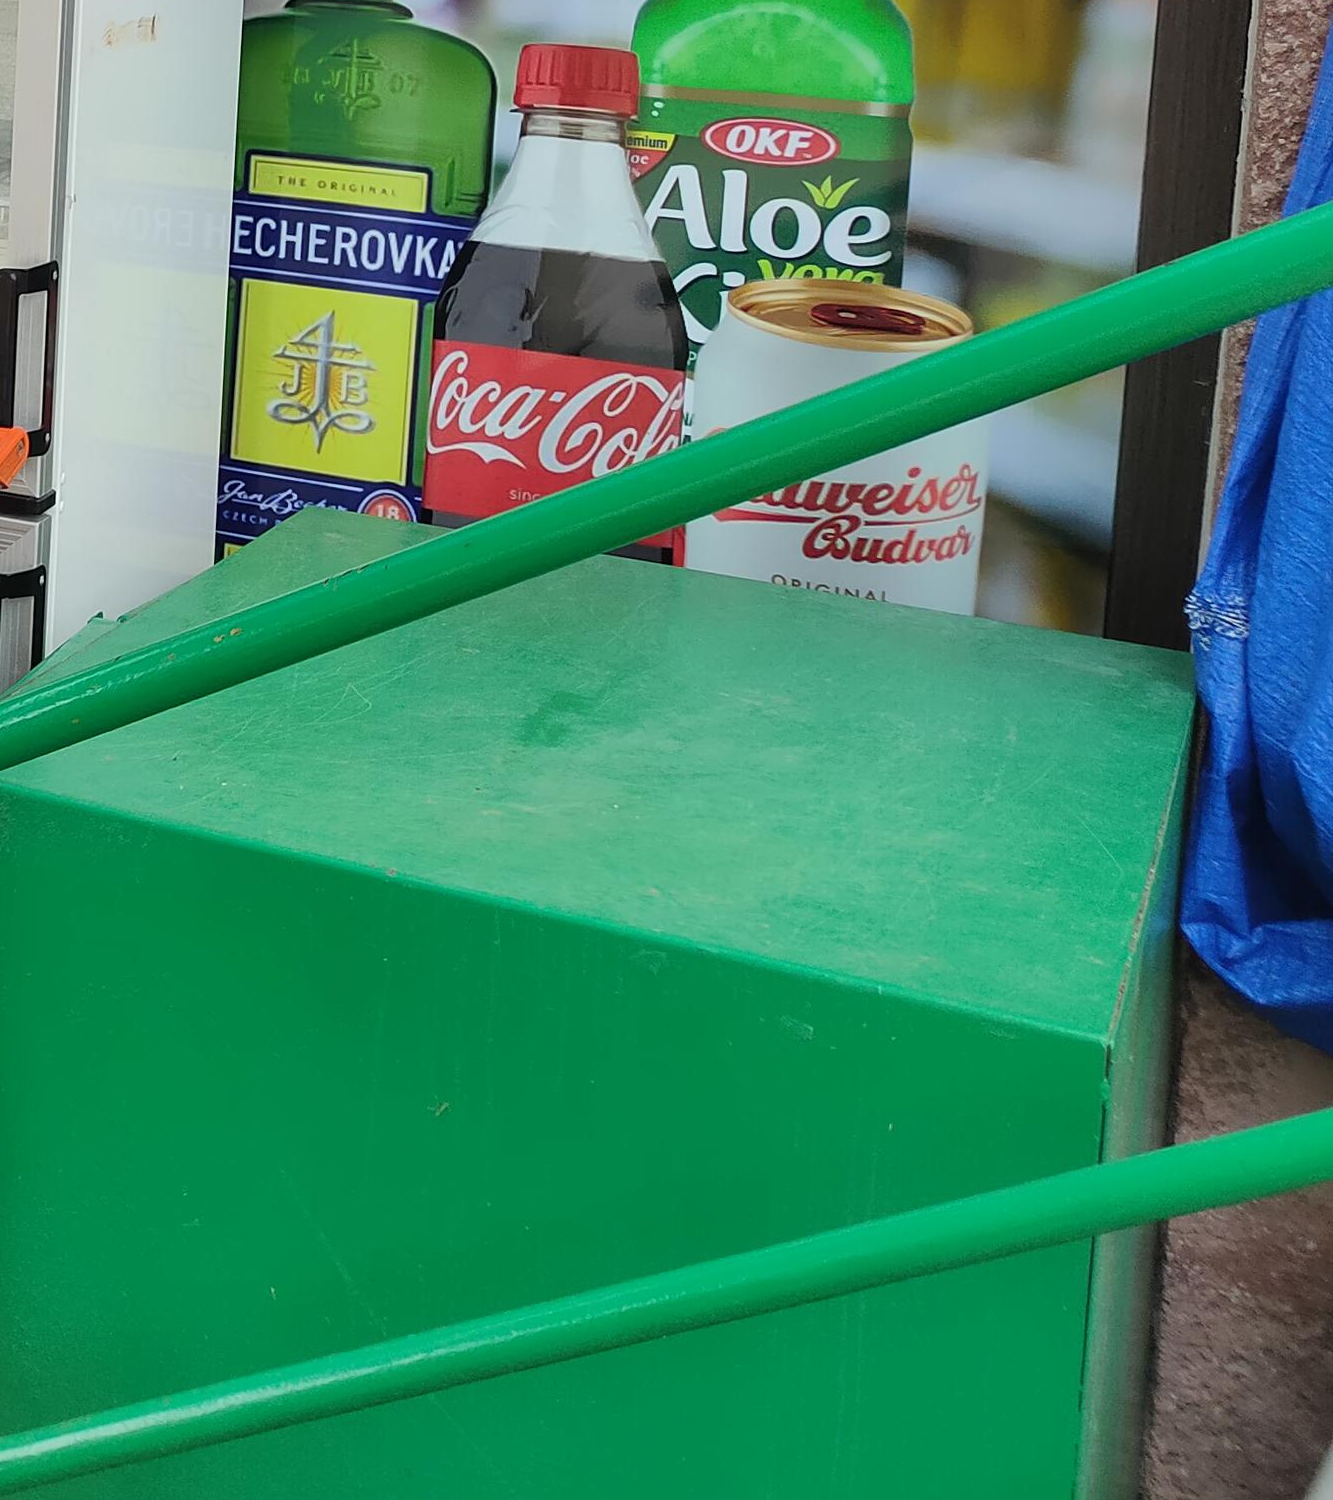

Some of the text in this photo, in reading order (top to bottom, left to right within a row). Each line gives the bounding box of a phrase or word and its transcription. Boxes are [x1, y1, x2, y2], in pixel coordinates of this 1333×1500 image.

[725, 123, 813, 159] OKF
[276, 174, 398, 198] THE ORIGINAL
[644, 164, 893, 267] Aloe
[802, 513, 975, 565] Budvar
